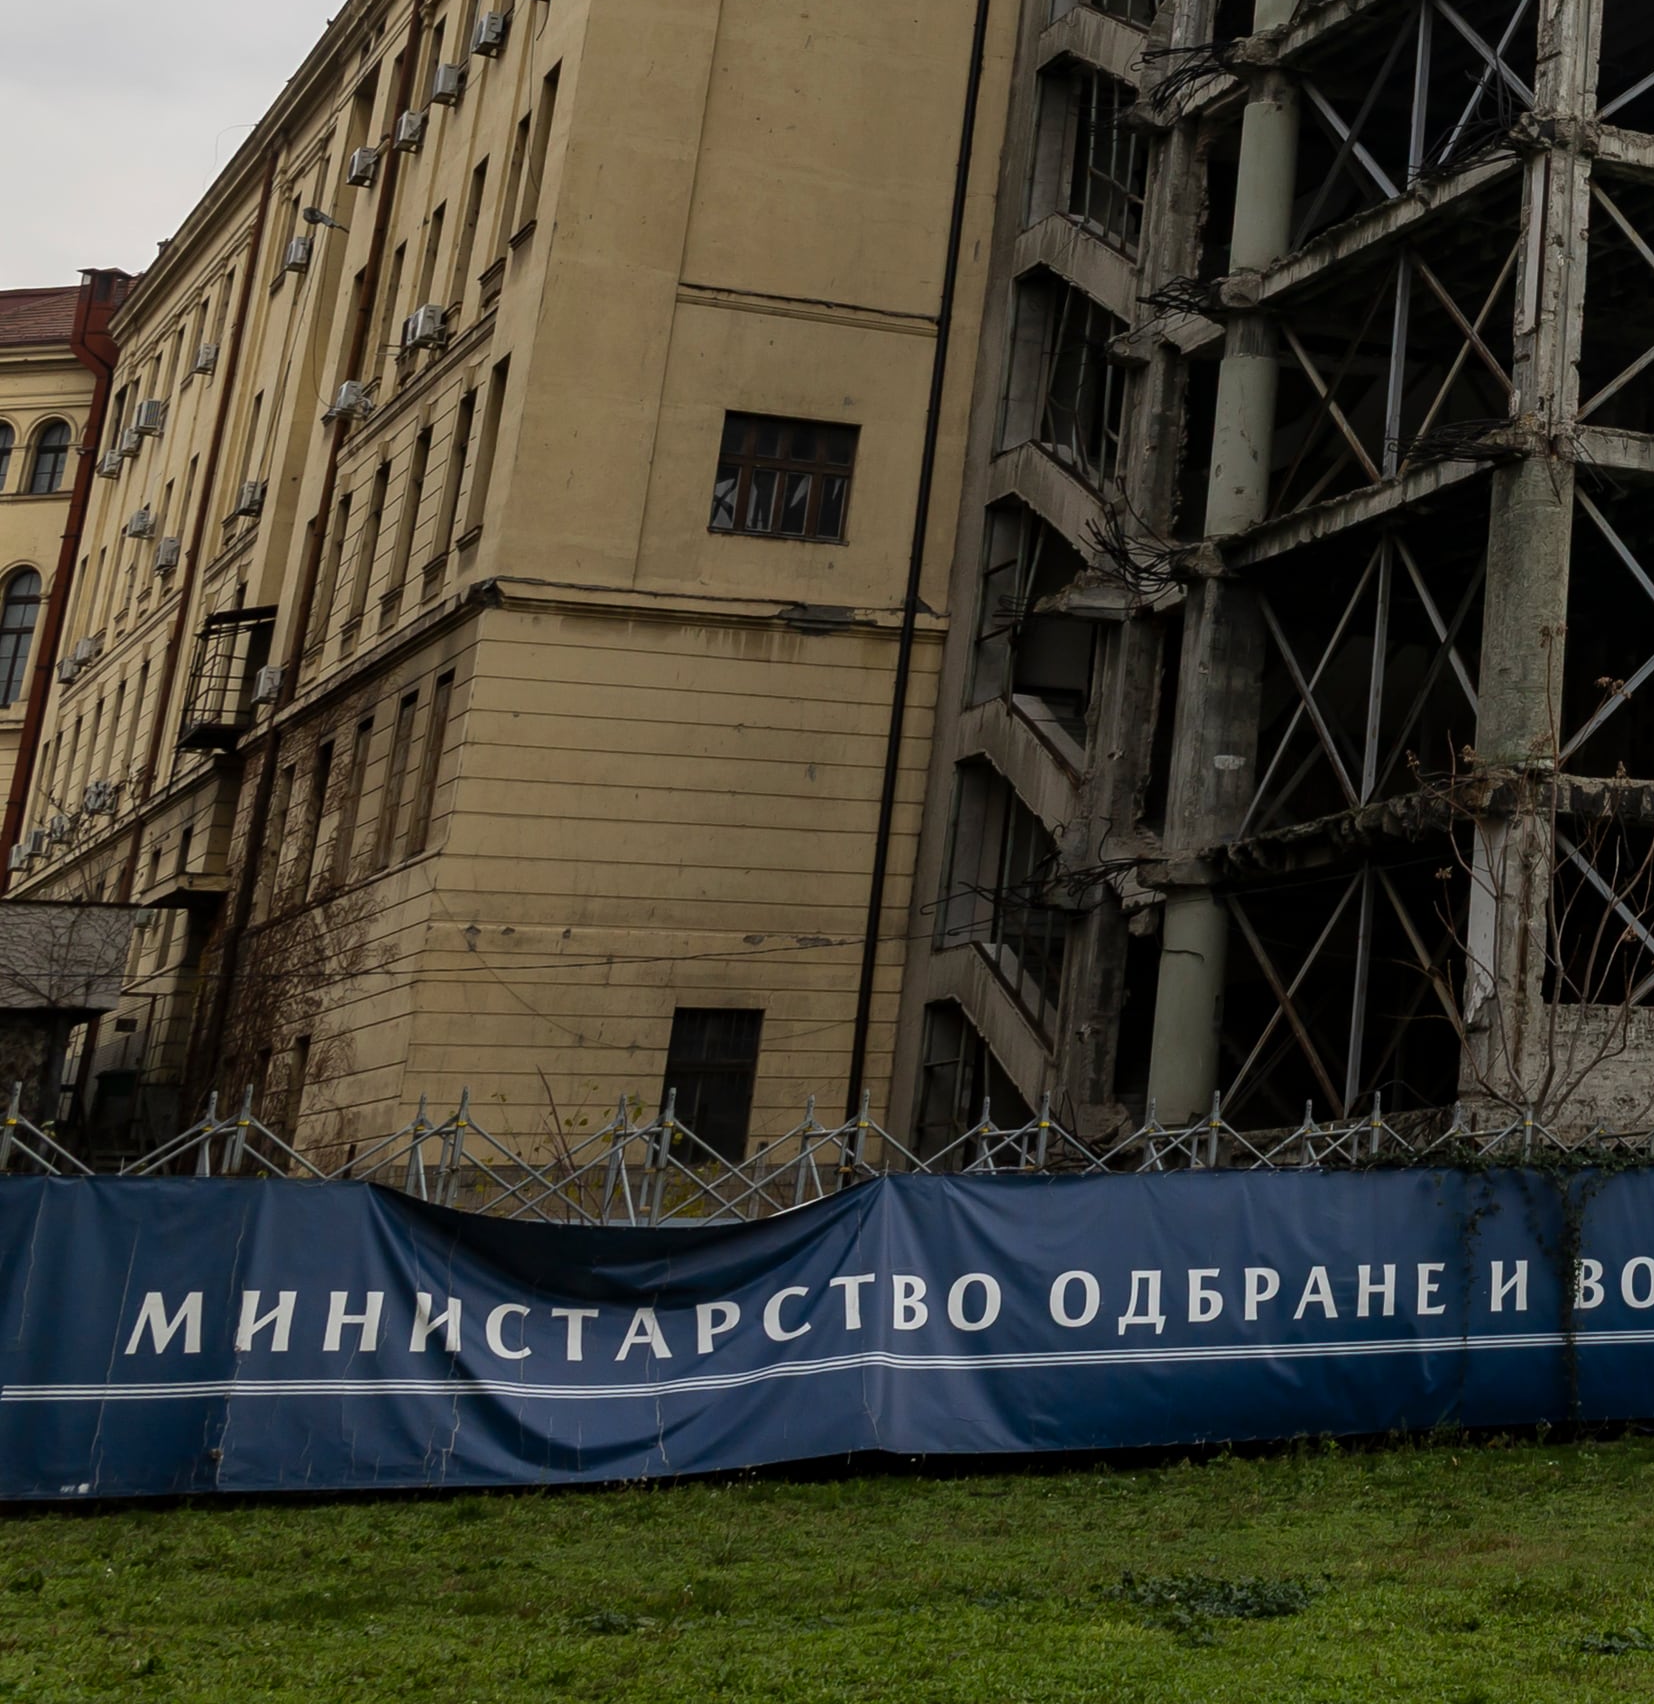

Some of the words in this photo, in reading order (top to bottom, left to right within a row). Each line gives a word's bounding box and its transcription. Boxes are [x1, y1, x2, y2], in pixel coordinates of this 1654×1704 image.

[124, 1272, 1002, 1362] МИНИСТАРСТВО
[1049, 1262, 1446, 1336] ОДБРАНЕ
[1490, 1259, 1529, 1313] И
